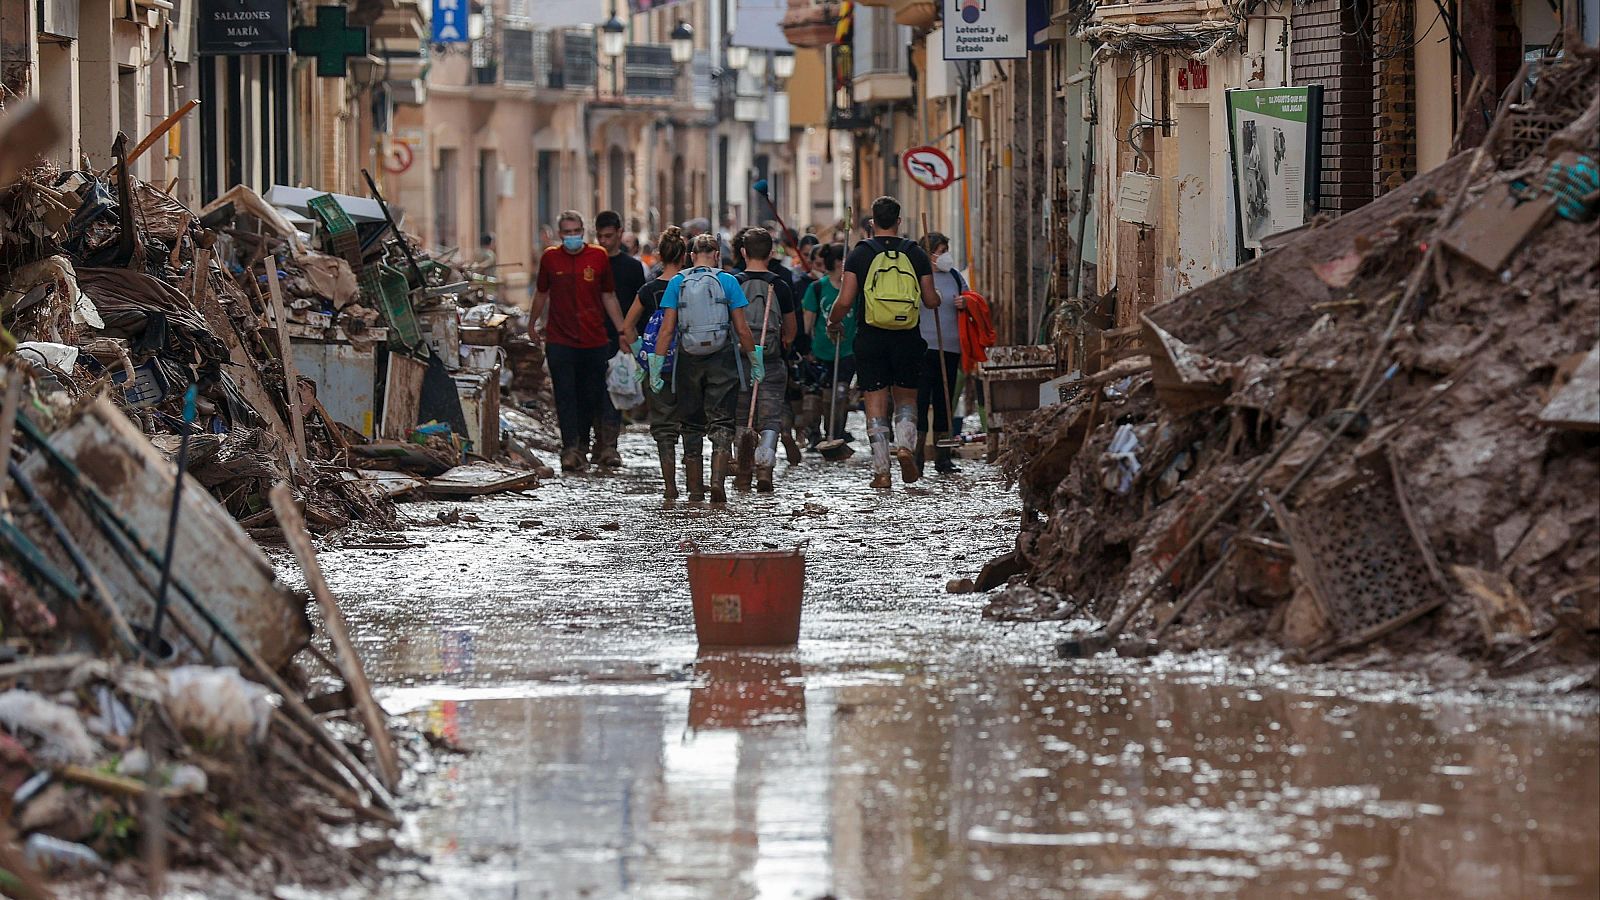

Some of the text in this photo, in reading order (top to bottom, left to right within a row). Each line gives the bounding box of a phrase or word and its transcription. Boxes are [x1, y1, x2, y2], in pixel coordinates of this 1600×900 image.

[214, 11, 271, 20] SALAZONES
[227, 25, 260, 36] MARÍA
[955, 25, 996, 35] Loterías y
[955, 34, 1009, 44] Apuestas del
[955, 44, 984, 53] Estado
